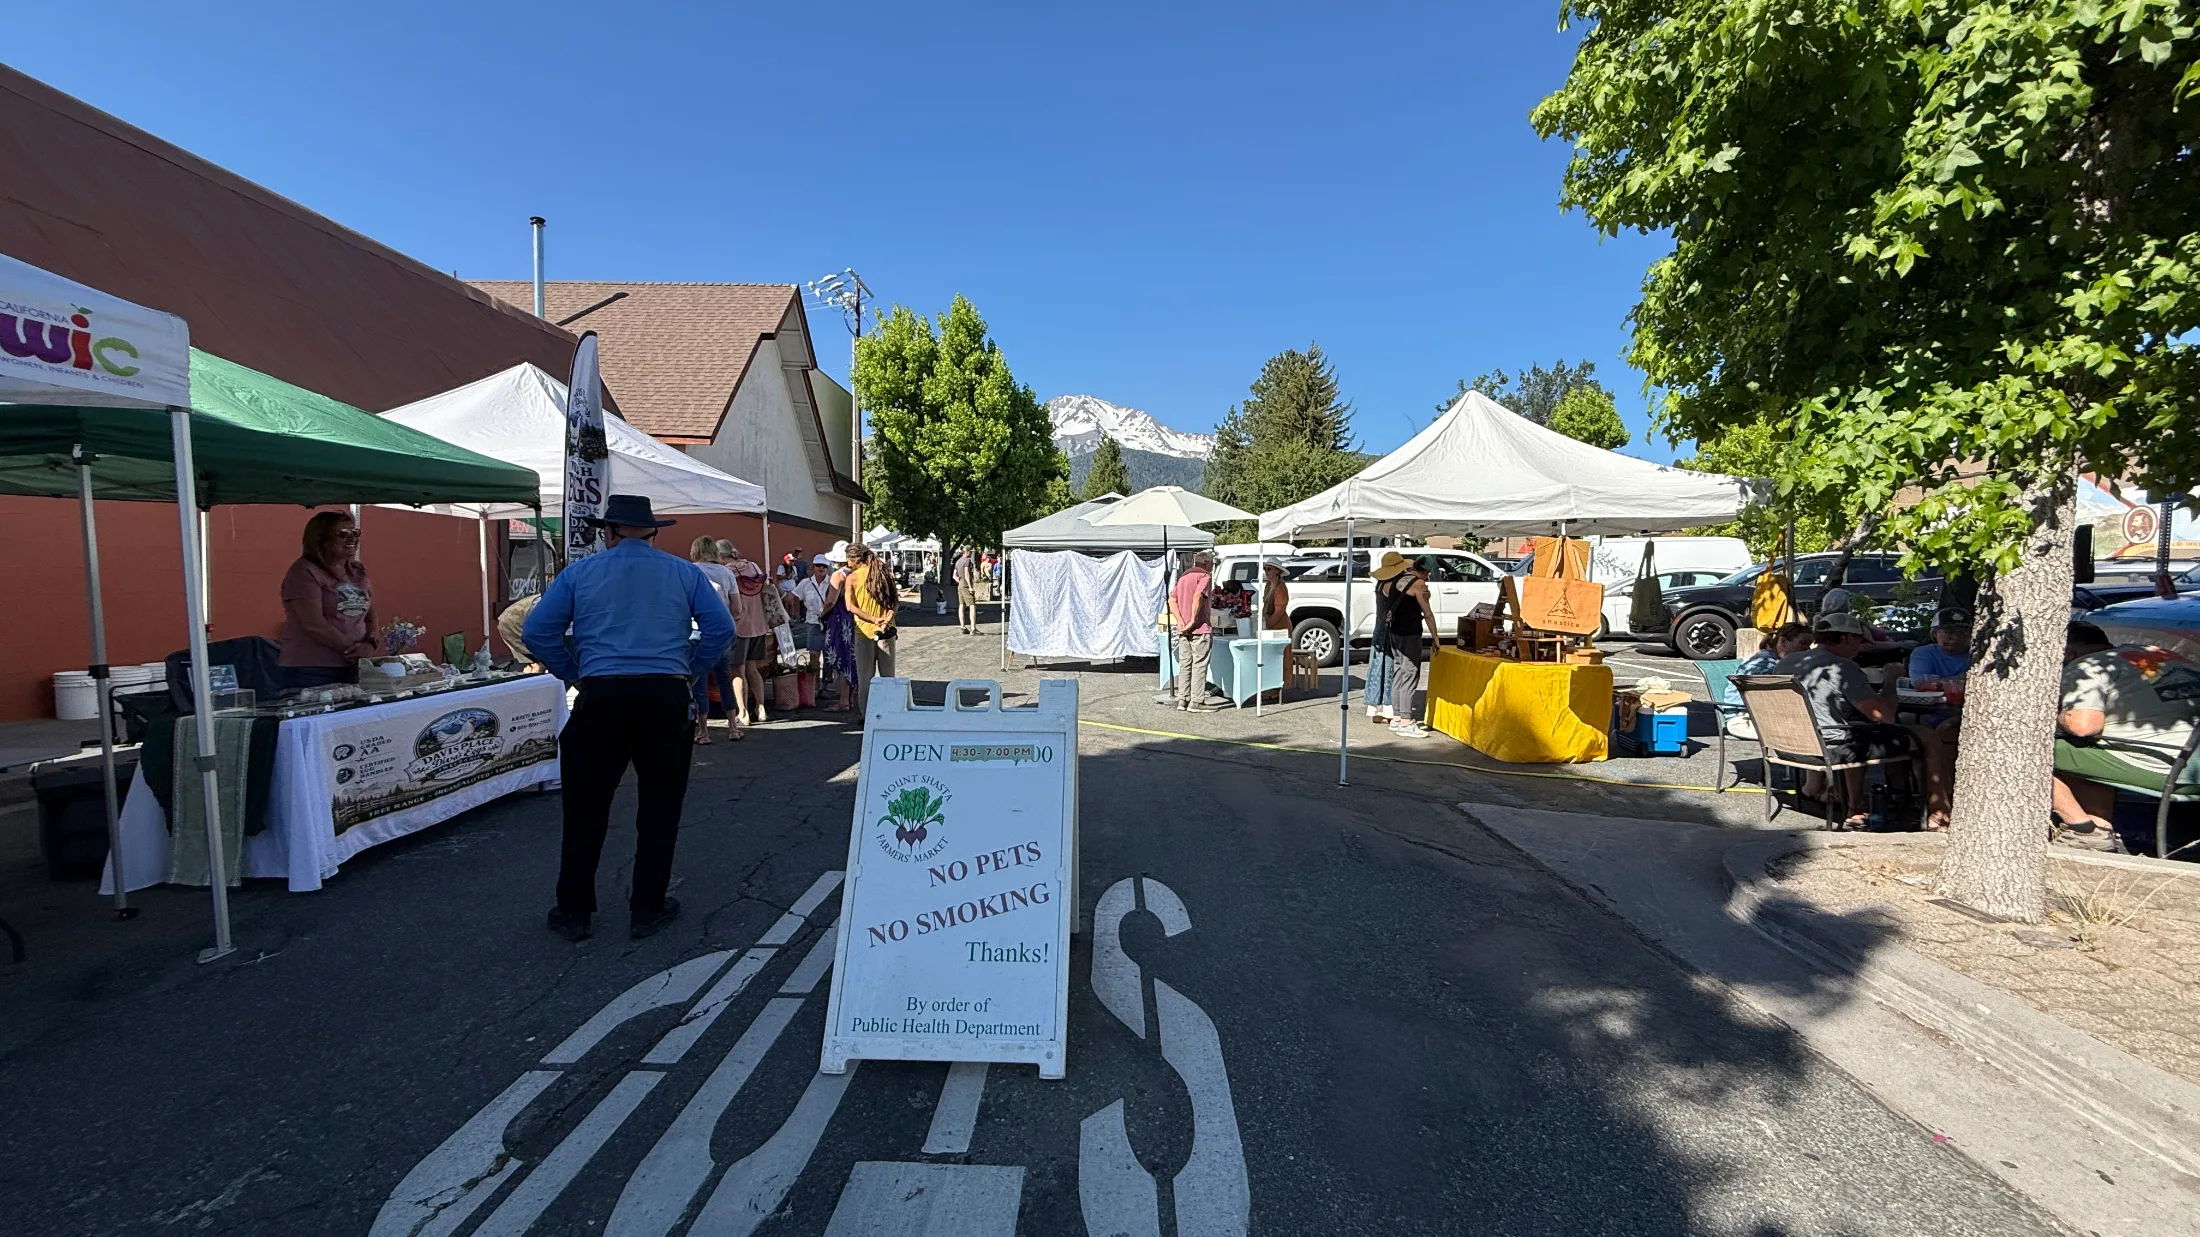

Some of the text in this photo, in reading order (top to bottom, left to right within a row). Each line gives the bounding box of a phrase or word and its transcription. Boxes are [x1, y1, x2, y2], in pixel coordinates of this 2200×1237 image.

[0, 300, 70, 325] CALIFORNIA
[0, 313, 140, 377] wic
[101, 375, 144, 389] CHILDREN
[509, 518, 529, 533] PEN
[1542, 619, 1580, 628] shastica
[360, 736, 384, 745] USDA
[422, 745, 459, 764] DAVIS
[461, 738, 494, 750] PLACE
[883, 743, 944, 761] OPEN
[986, 748, 1010, 756] 7:00
[1013, 747, 1031, 756] PM
[360, 757, 396, 769] CERTIFIED
[880, 774, 953, 802] MOUNT SHASTA
[368, 806, 391, 817] FREE
[394, 796, 425, 809] RANGE
[914, 835, 949, 863] MARKET
[928, 840, 1042, 888] NO PETS
[867, 881, 1051, 948] NO SMOKING
[965, 941, 1049, 964] Thanks!
[907, 997, 992, 1016] By order of
[852, 1017, 1041, 1038] Public Health Department
